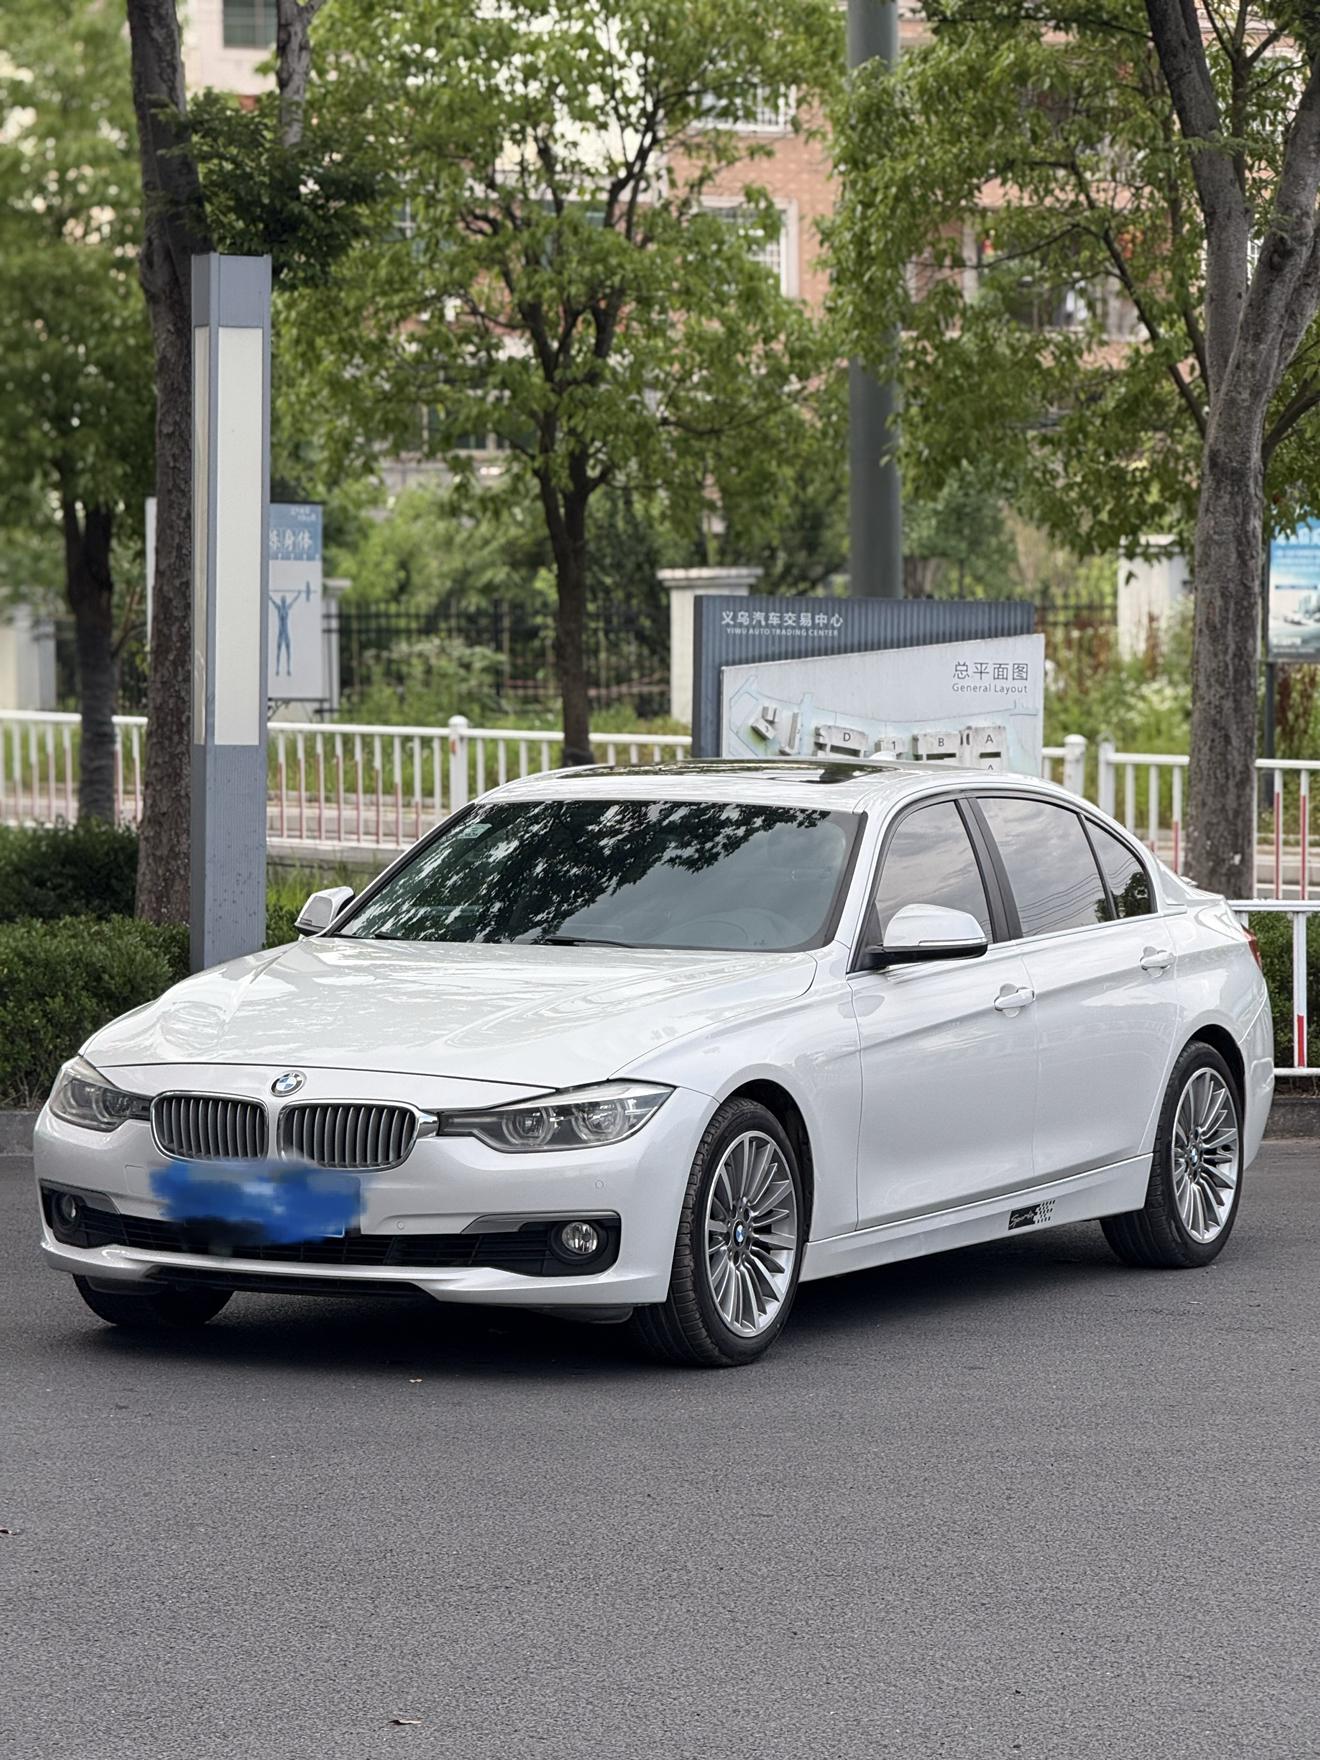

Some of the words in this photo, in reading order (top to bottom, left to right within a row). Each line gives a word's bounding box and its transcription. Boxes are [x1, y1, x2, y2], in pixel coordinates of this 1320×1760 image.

[721, 611, 844, 627] 义乌汽车交易中心
[772, 628, 806, 636] TRADING
[808, 629, 838, 637] CENTER
[953, 661, 1028, 681] 总平面图
[952, 682, 991, 693] General
[994, 683, 1028, 695] Layout
[842, 732, 851, 742] D
[937, 737, 945, 747] B
[985, 734, 994, 744] A
